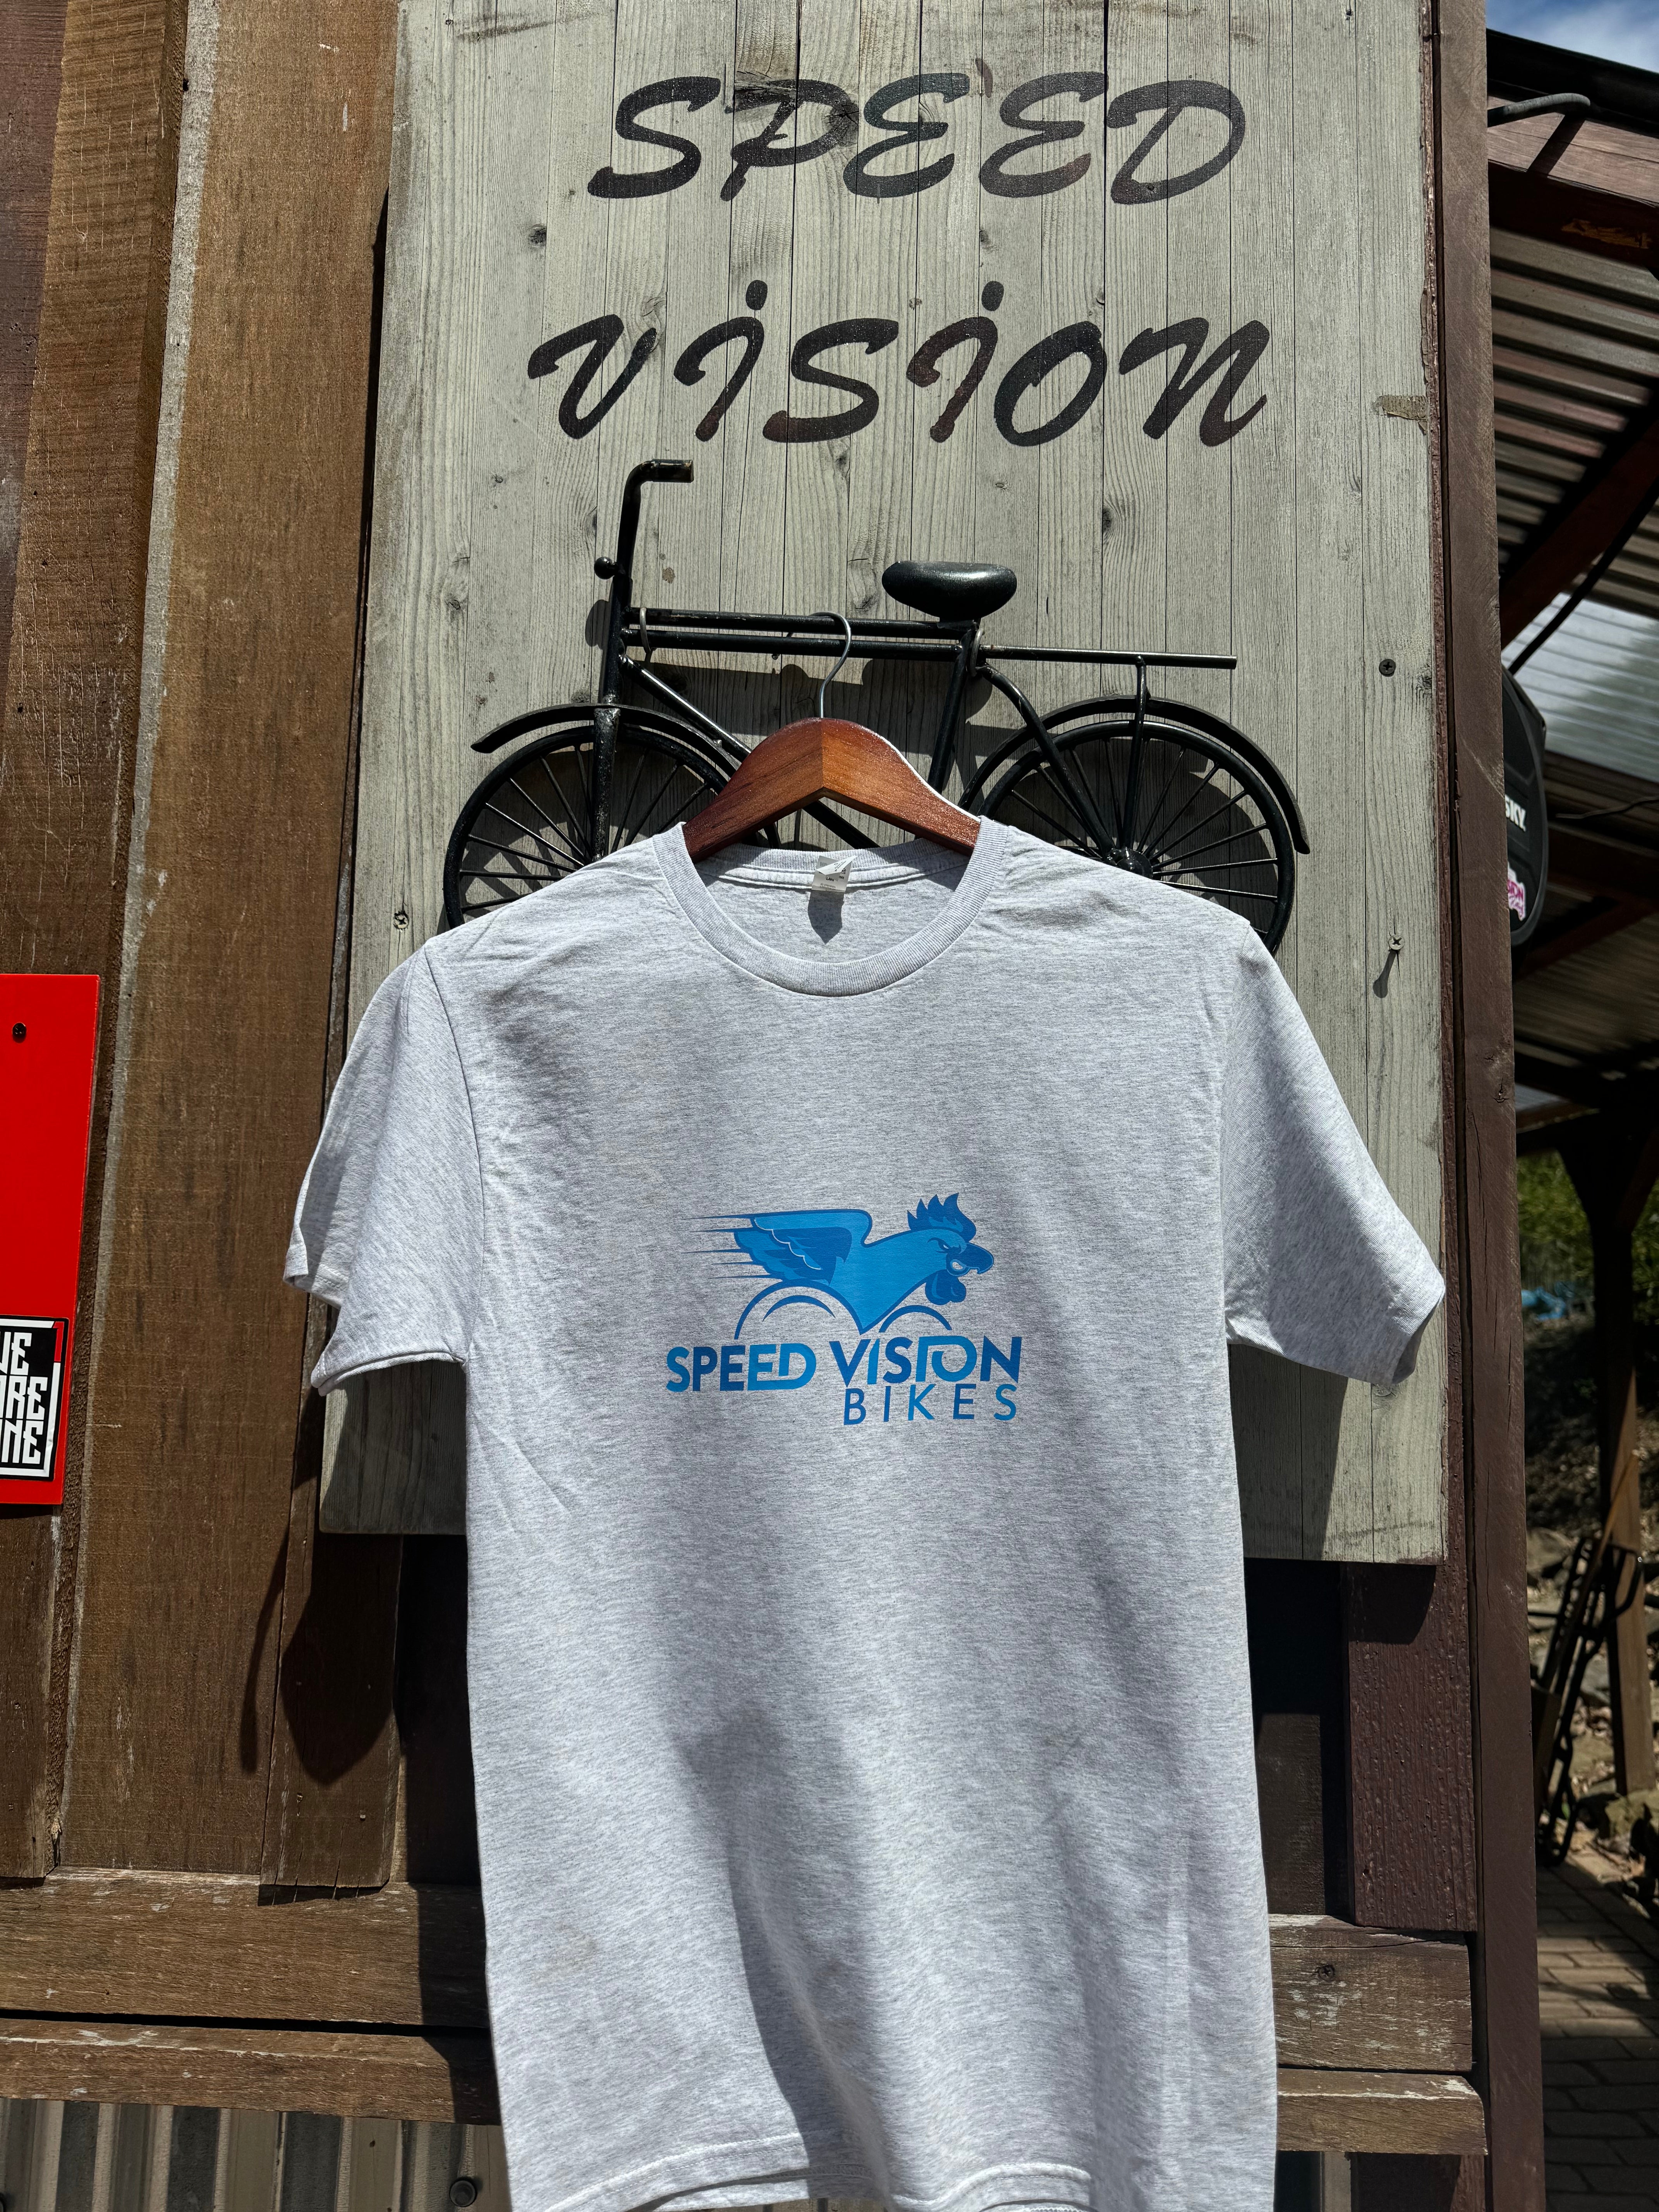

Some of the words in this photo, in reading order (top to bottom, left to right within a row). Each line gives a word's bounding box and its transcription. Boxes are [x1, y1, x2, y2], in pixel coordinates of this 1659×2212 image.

[587, 72, 1246, 204] SPEED
[666, 1343, 817, 1392] SPEED
[829, 1335, 1022, 1388] VISION
[843, 1383, 1017, 1425] BIKES
[0, 1419, 44, 1464] NE
